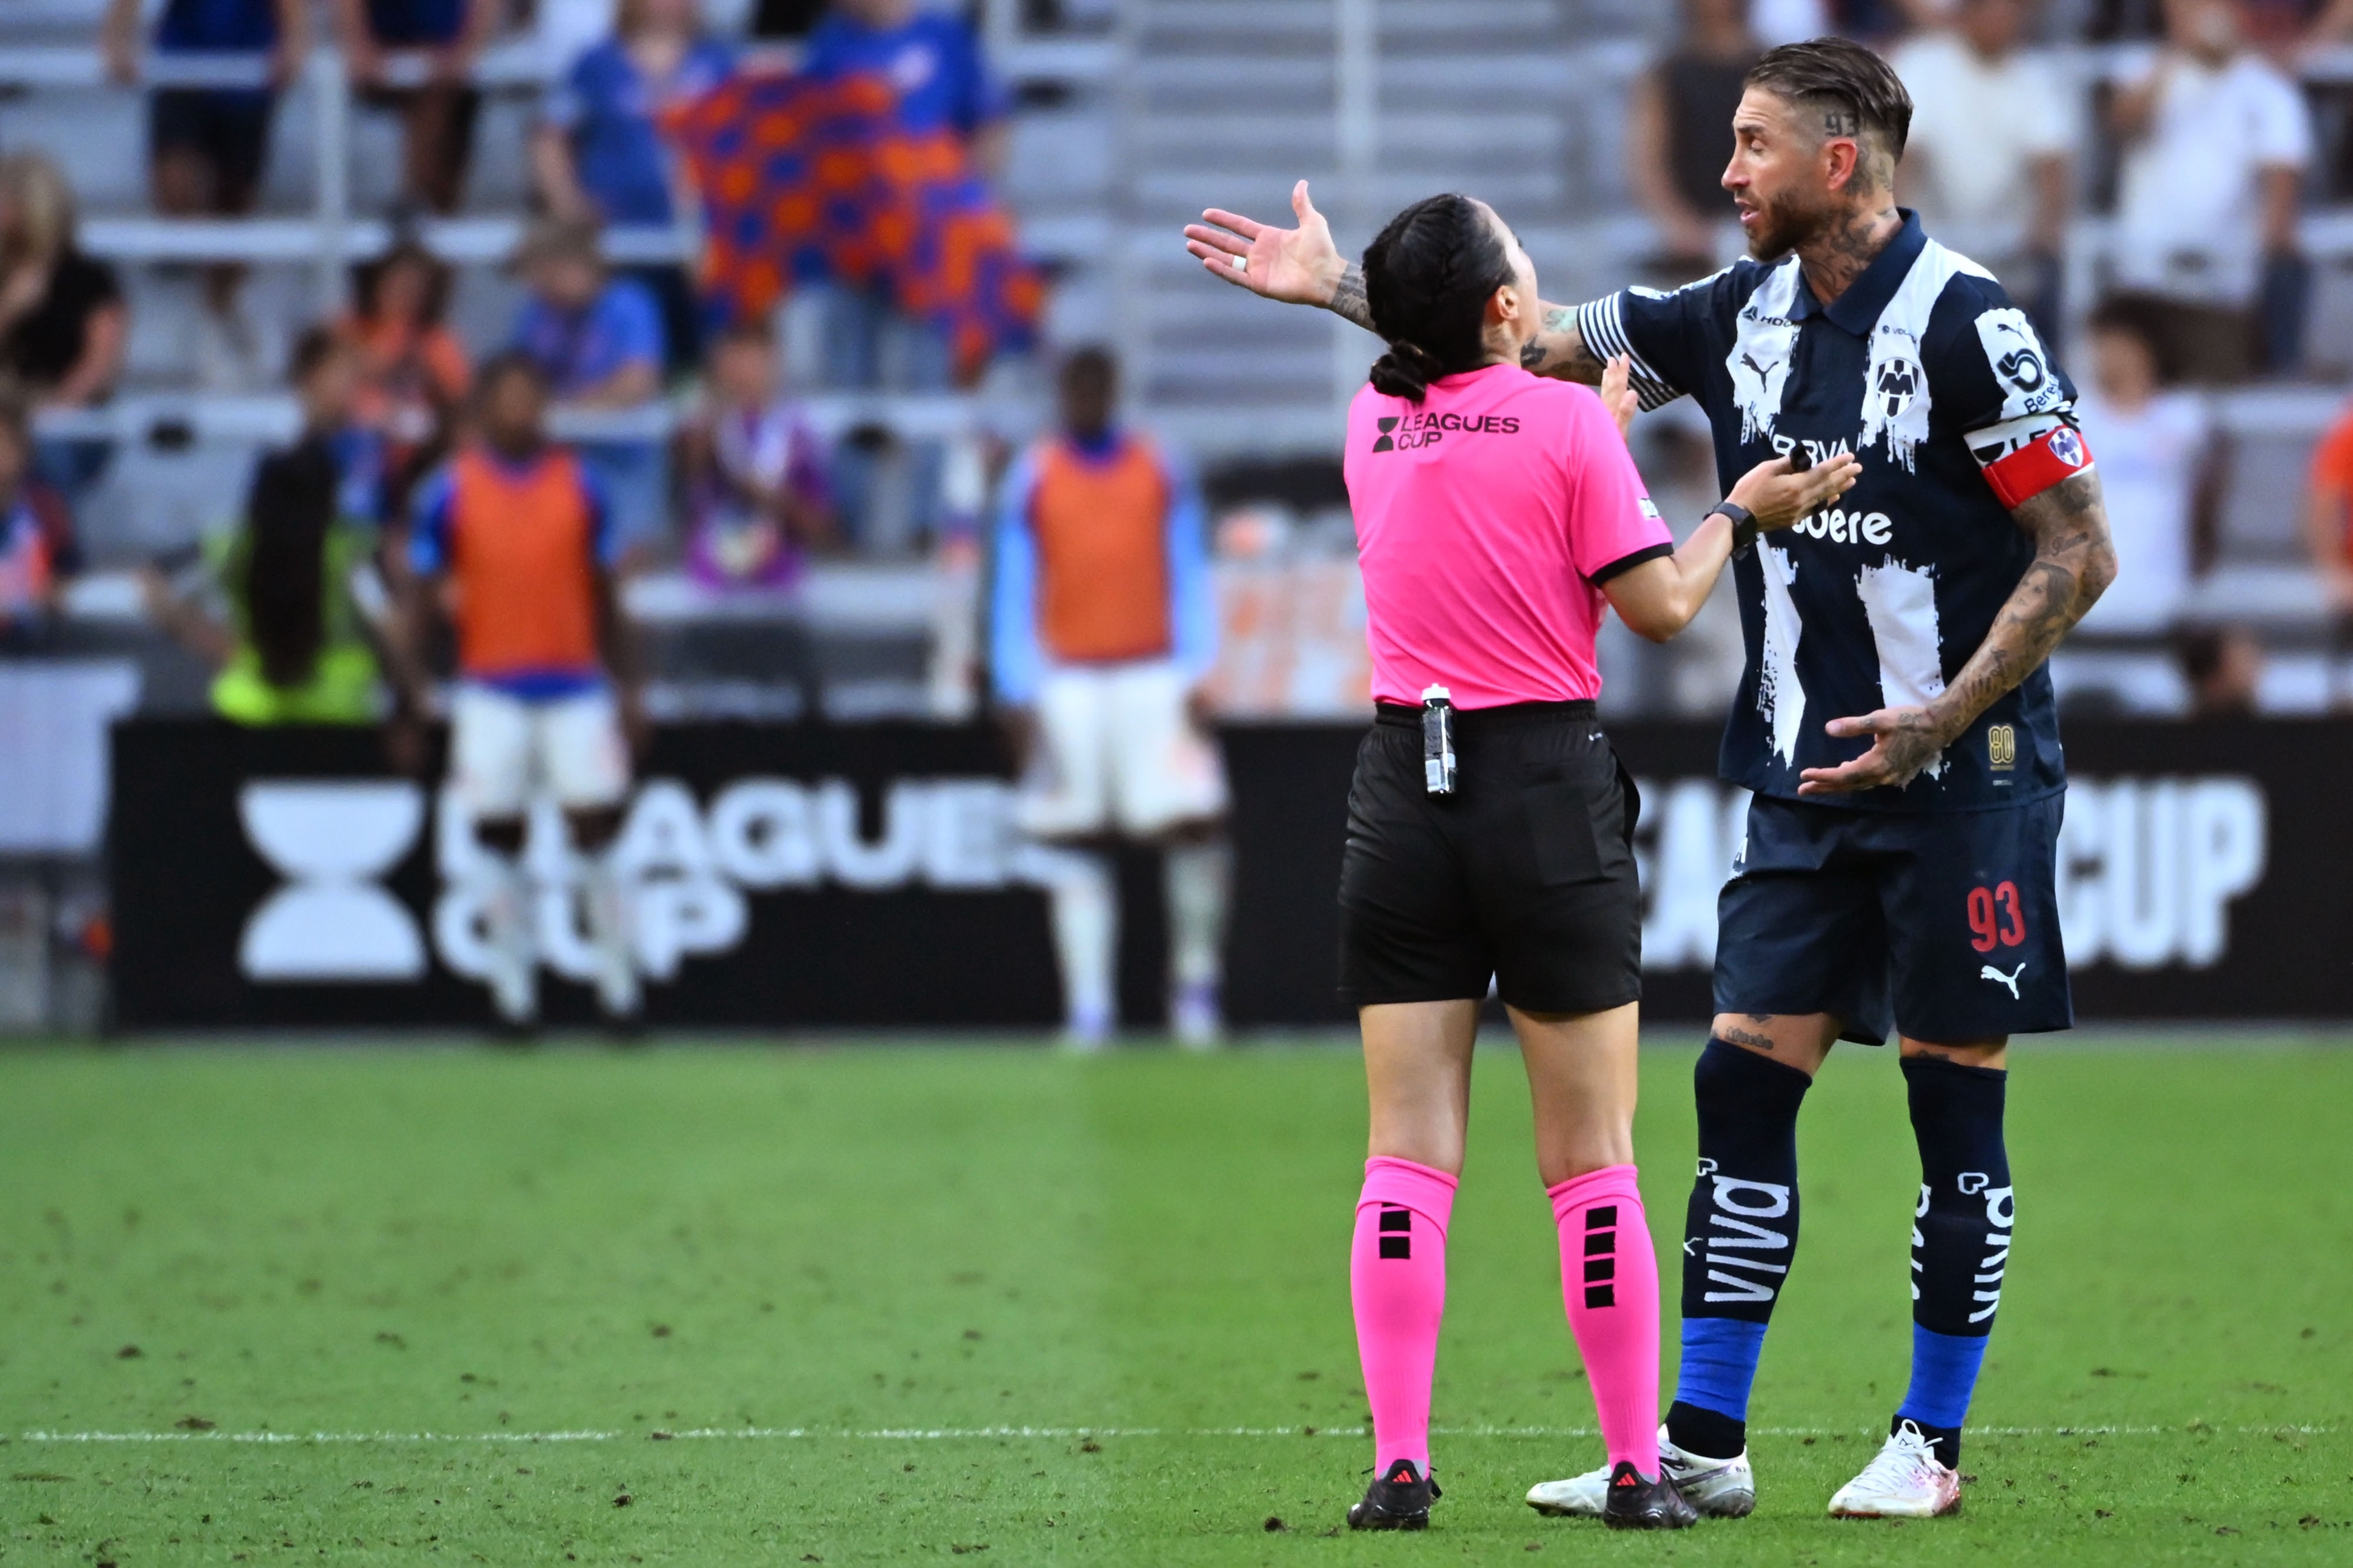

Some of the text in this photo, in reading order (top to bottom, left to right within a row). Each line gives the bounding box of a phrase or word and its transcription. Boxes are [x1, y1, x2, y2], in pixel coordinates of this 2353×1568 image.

[1398, 431, 1442, 451] CUP
[1401, 412, 1520, 433] LEAGUES
[1988, 725, 2015, 764] 80
[2055, 779, 2265, 969] CUP
[434, 883, 747, 979] CUP
[1967, 880, 2025, 952] 93
